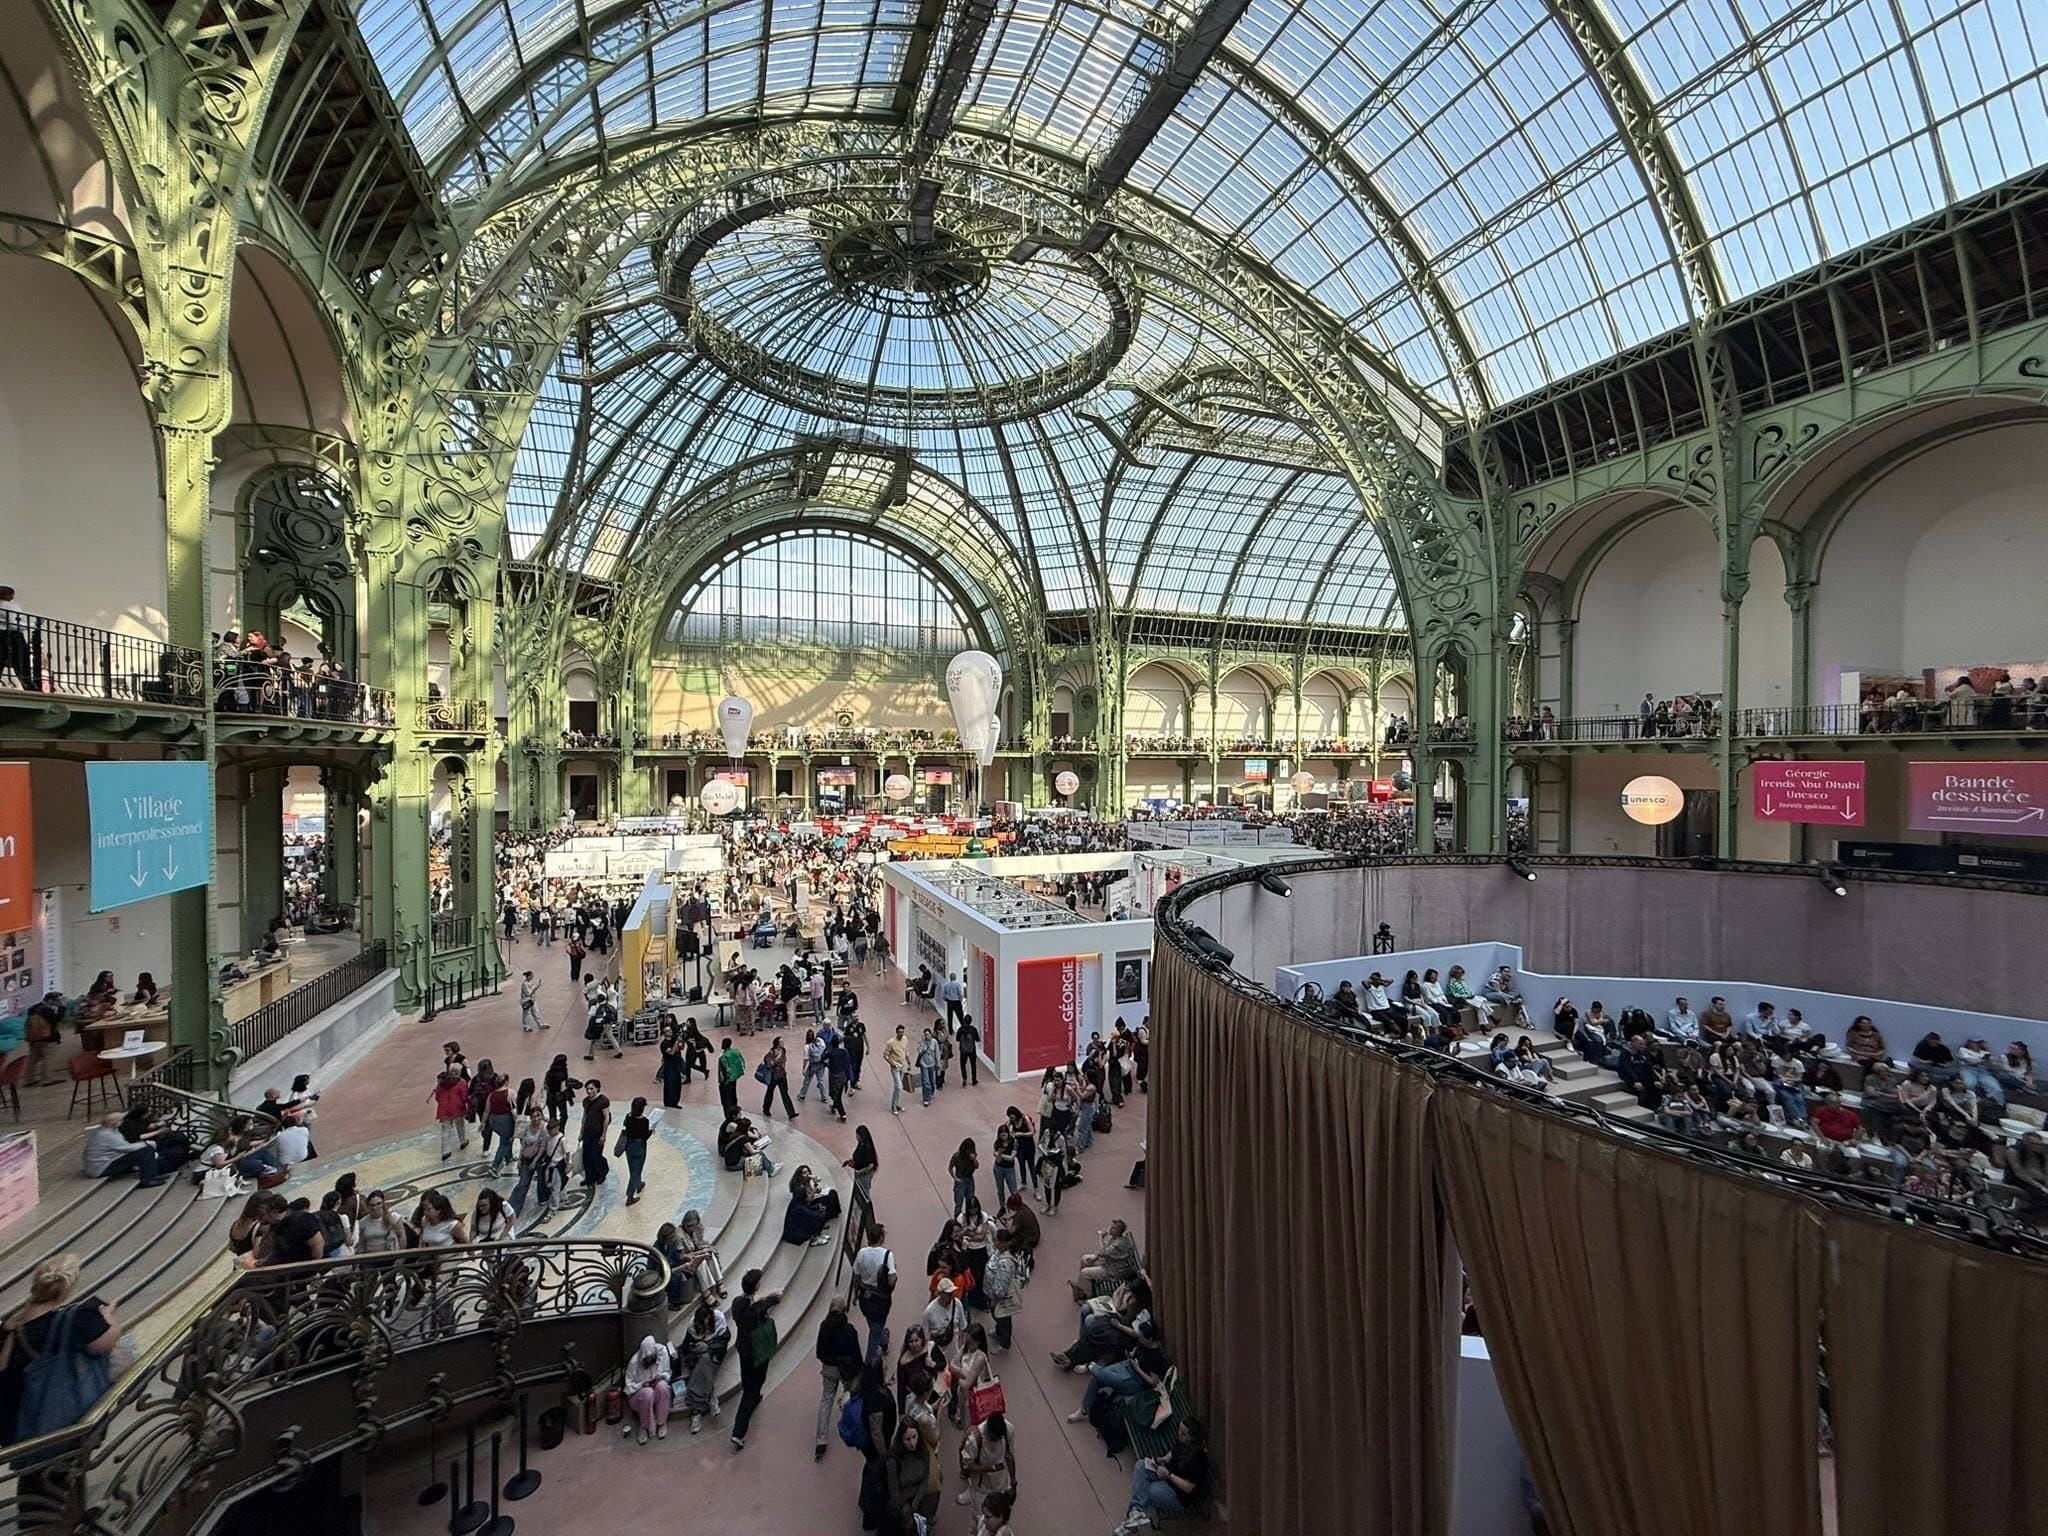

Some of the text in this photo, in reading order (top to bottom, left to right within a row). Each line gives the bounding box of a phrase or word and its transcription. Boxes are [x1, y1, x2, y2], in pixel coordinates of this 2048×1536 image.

[1785, 769, 1831, 779] Géorgie
[1801, 780, 1821, 789] Abu
[1825, 780, 1860, 789] Dhabi
[1945, 775, 2016, 788] Bande
[1629, 796, 1666, 804] unesco
[1786, 790, 1829, 799] Unesco
[1932, 789, 2031, 803] dessinée
[123, 796, 183, 821] Village
[97, 822, 203, 848] interprofessionnel
[1059, 961, 1074, 1022] GÉORGIE
